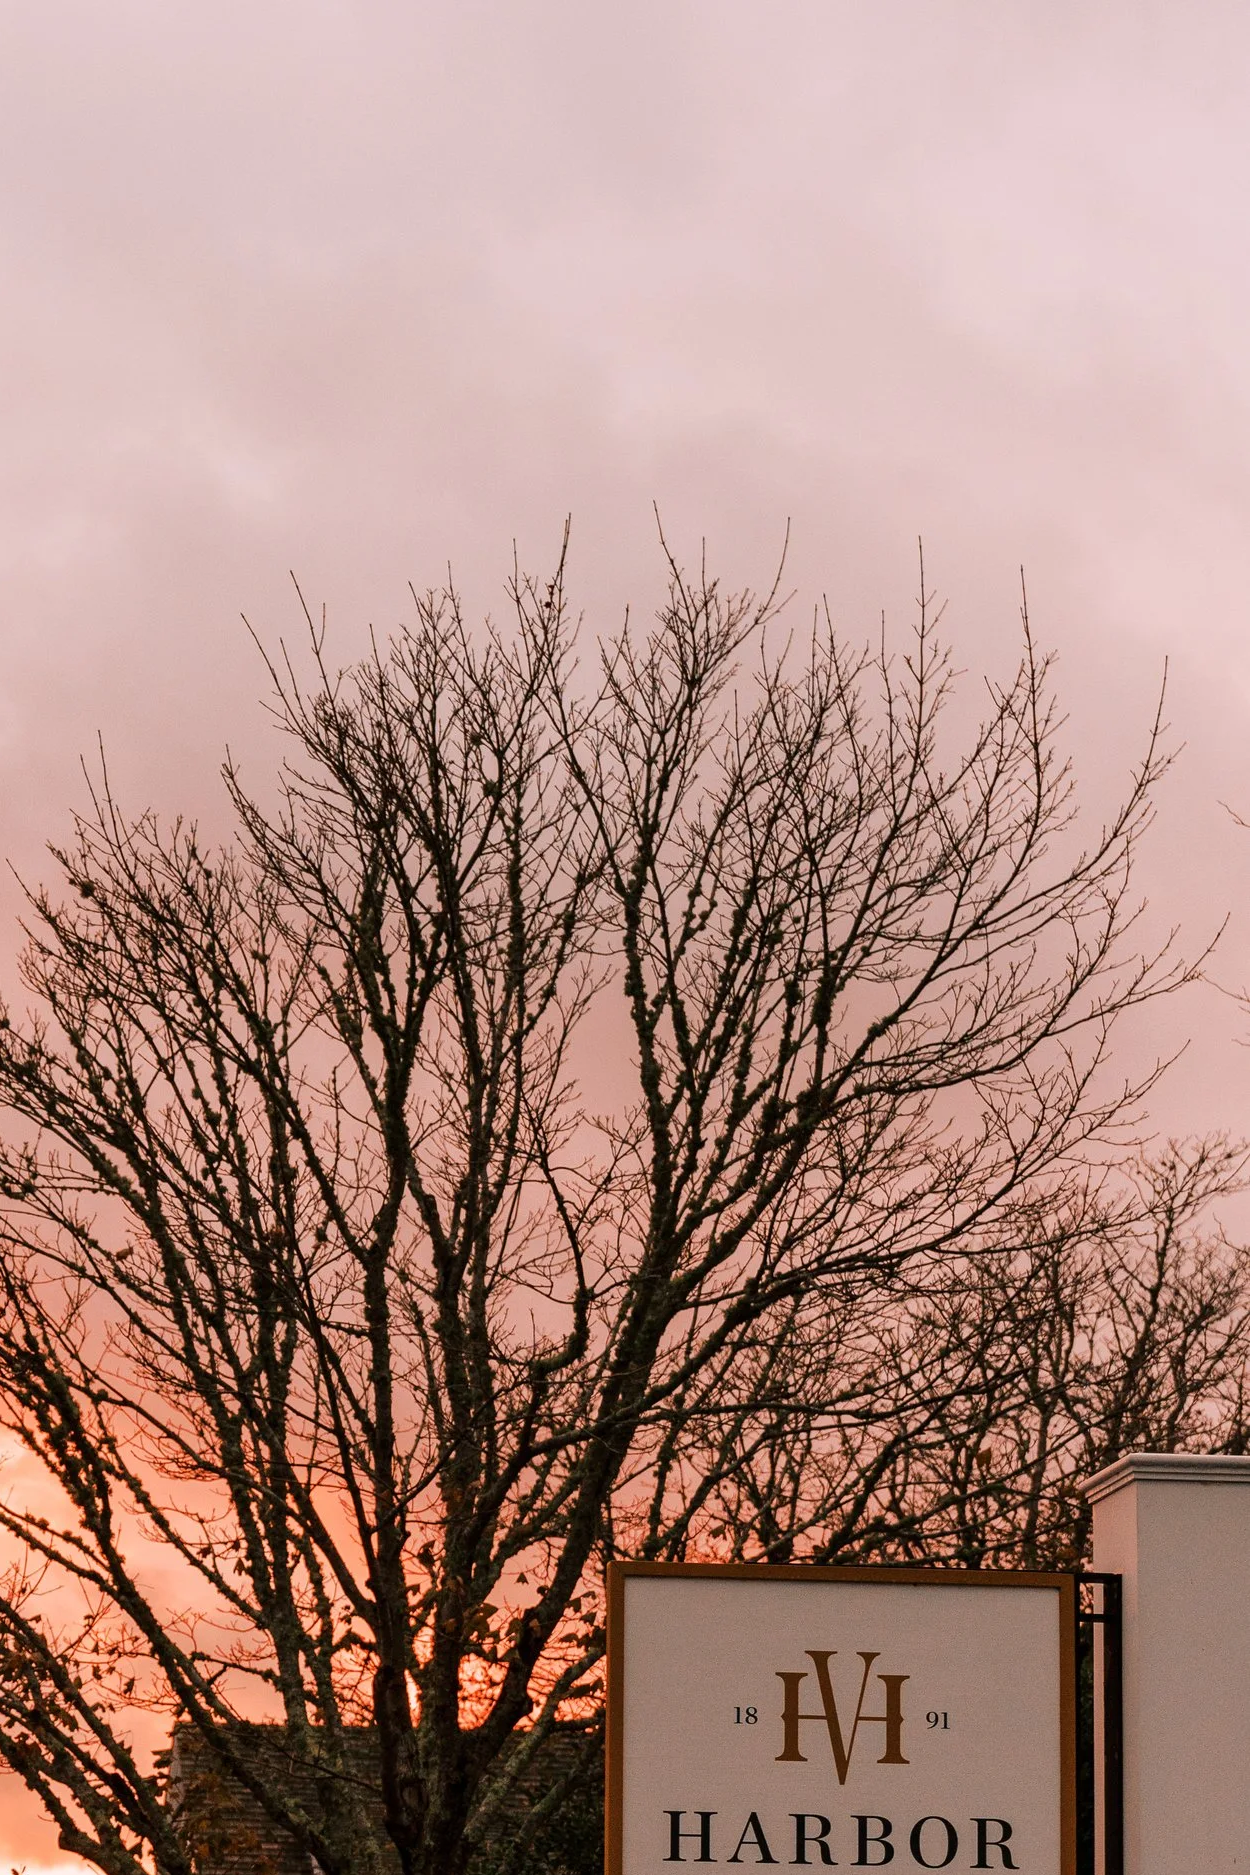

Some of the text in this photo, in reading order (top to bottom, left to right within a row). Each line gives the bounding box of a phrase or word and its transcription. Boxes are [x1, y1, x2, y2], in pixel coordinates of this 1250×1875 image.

[734, 1706, 758, 1725] 18
[925, 1711, 950, 1730] 91
[662, 1810, 1021, 1870] HARBOR
